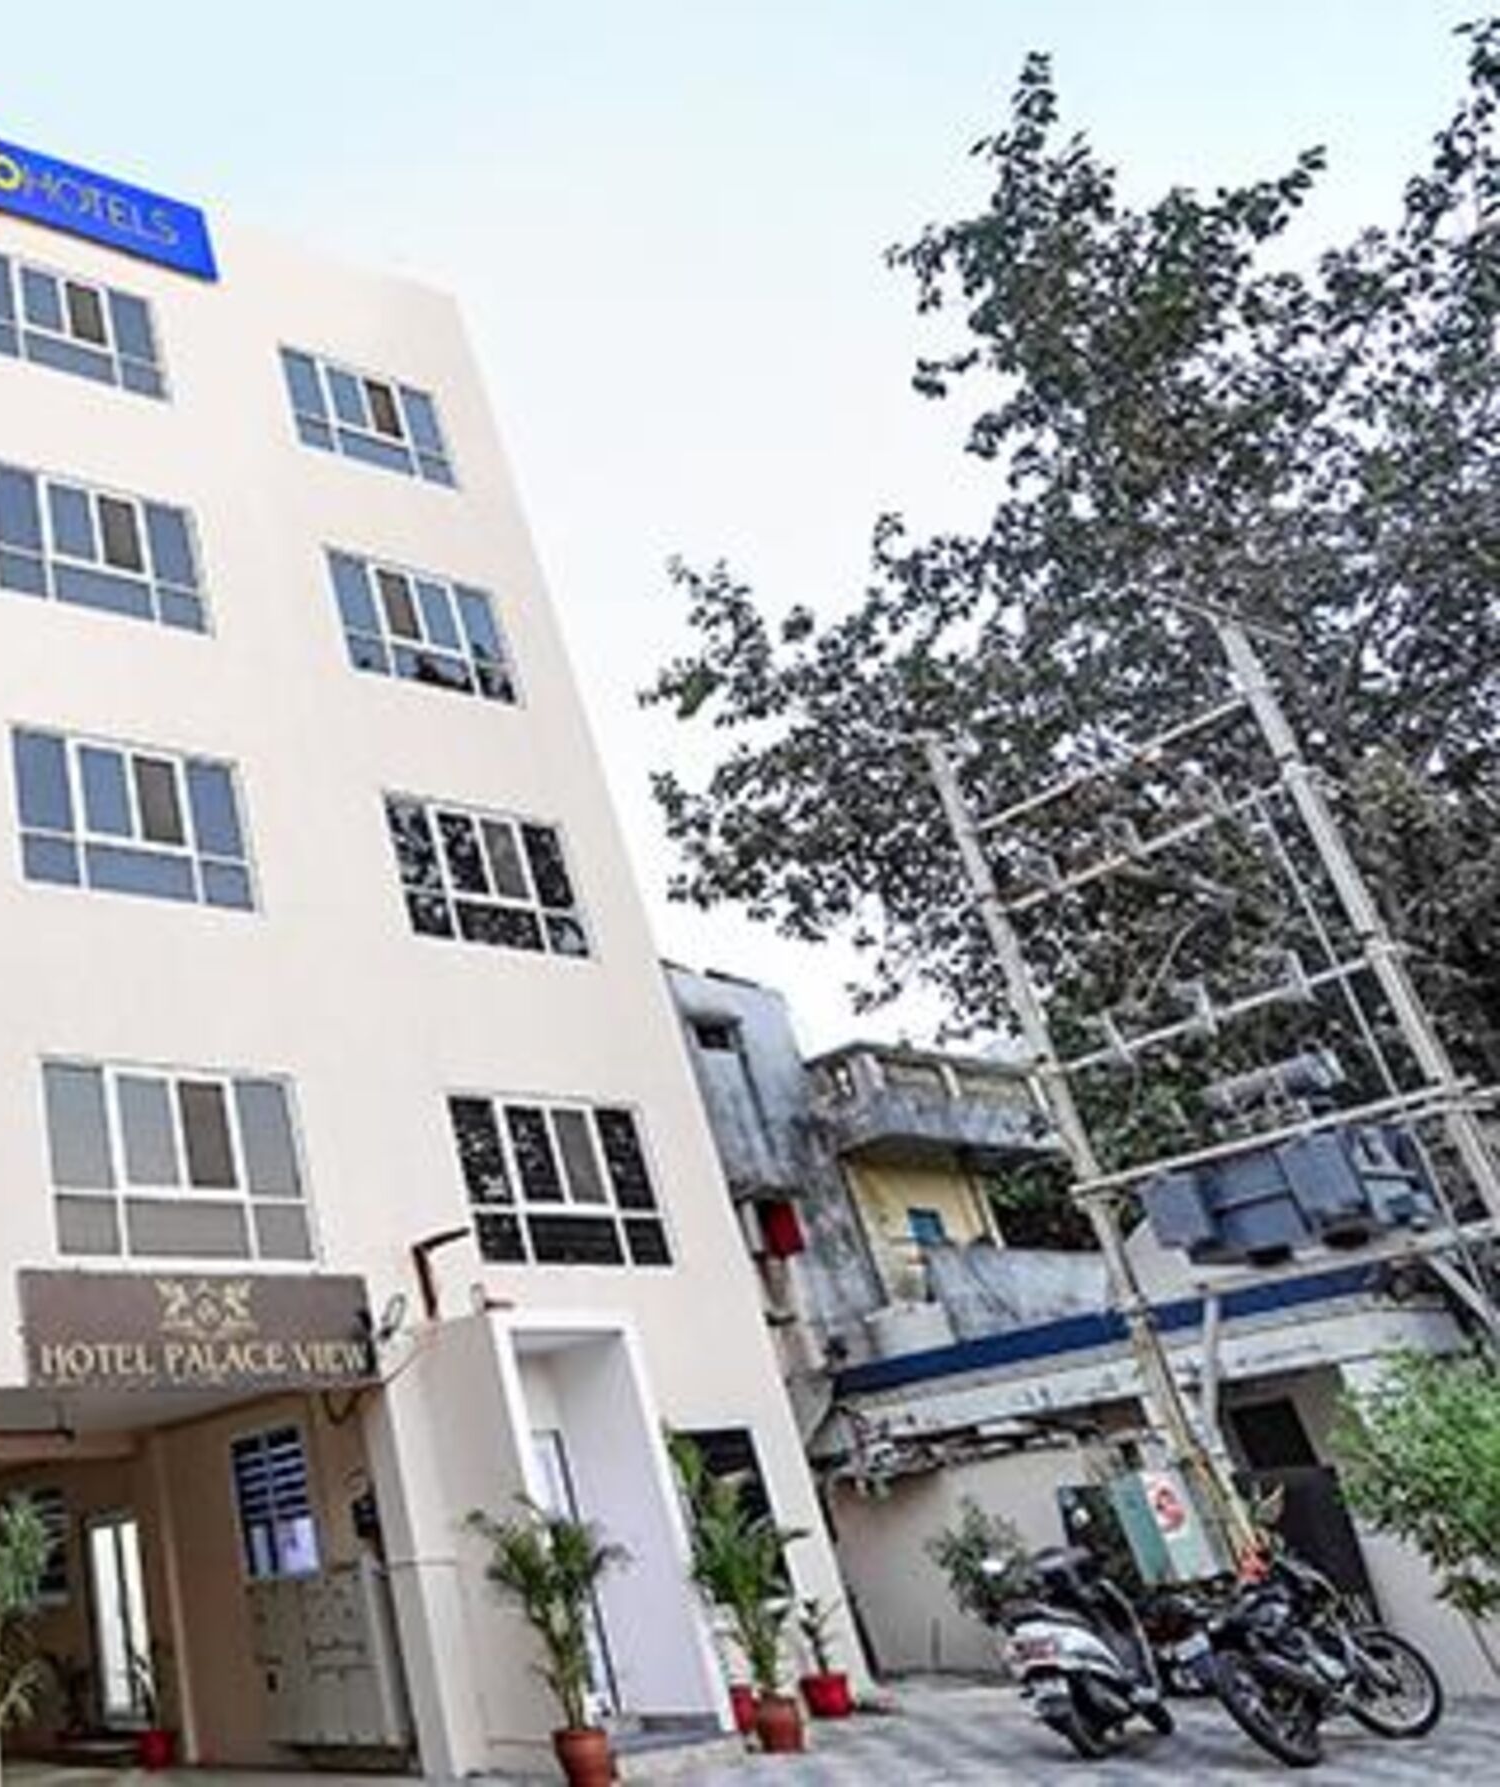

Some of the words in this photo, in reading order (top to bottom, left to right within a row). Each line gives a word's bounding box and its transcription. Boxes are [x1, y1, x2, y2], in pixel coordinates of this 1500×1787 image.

[39, 1341, 156, 1380] HOTEL
[163, 1341, 287, 1381] PALACE
[288, 1339, 367, 1375] VIEW
